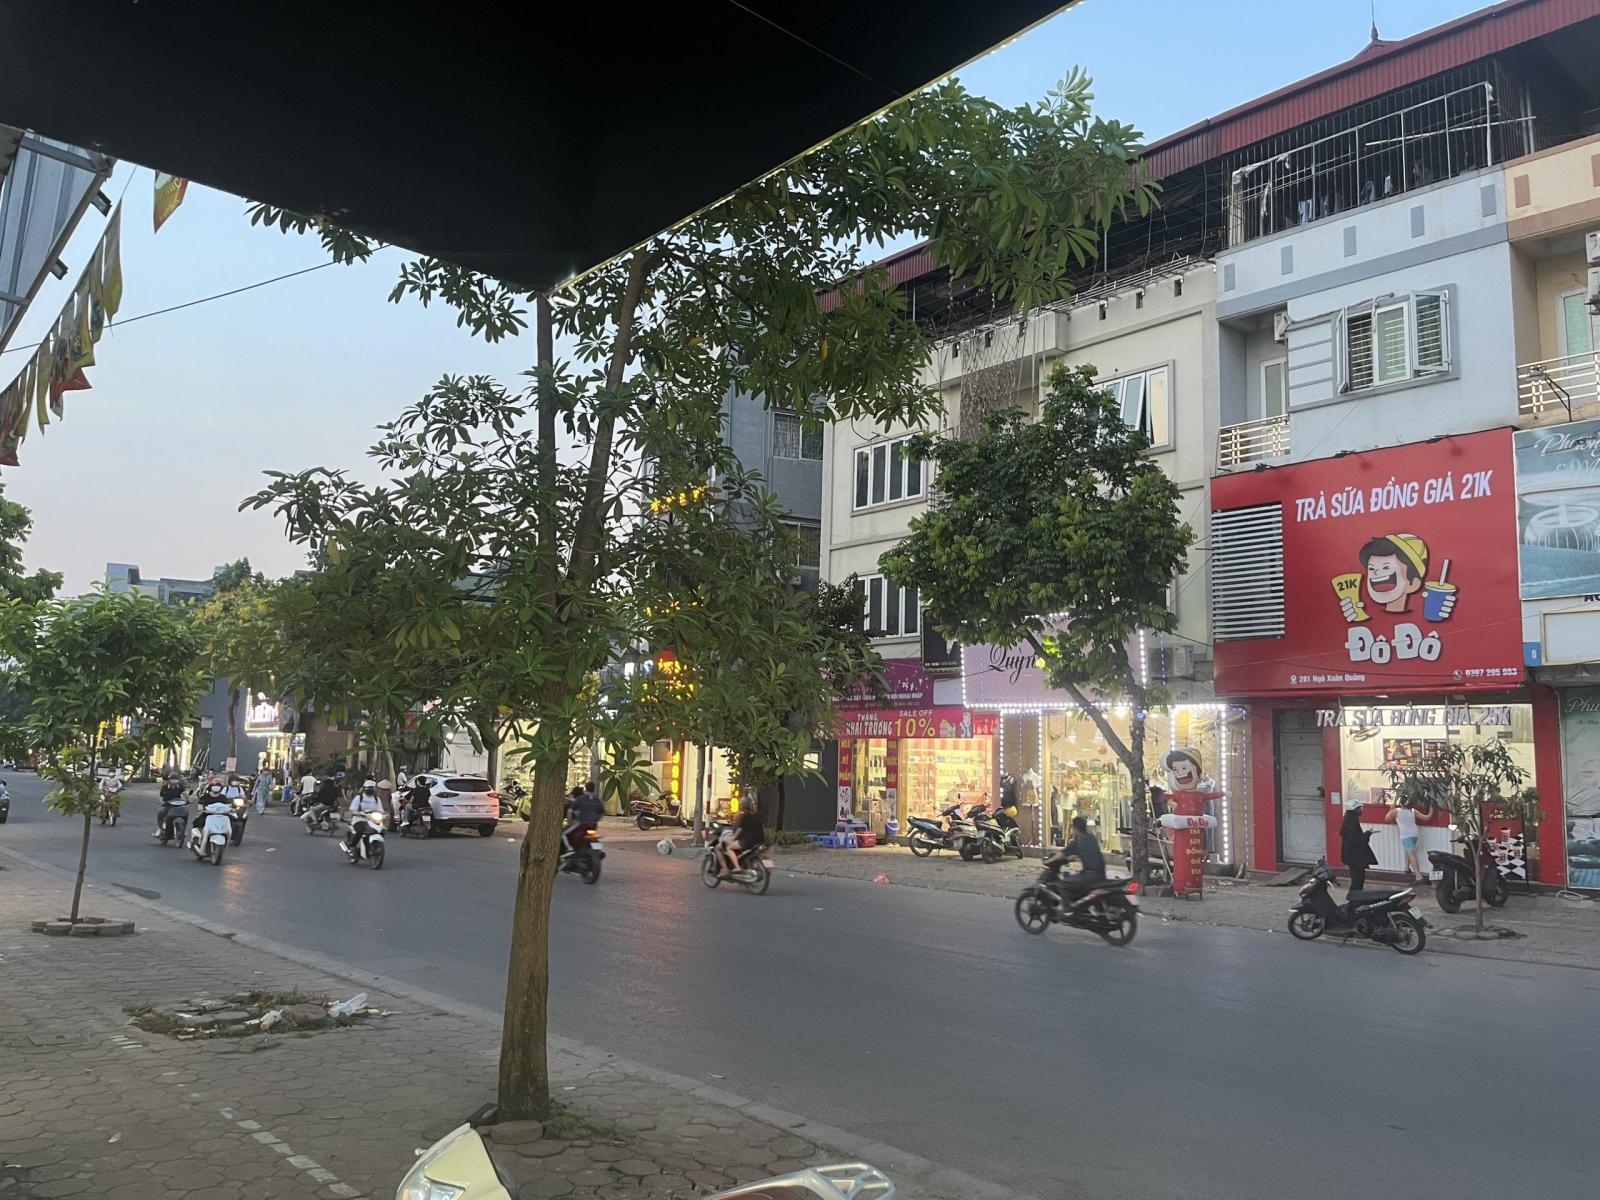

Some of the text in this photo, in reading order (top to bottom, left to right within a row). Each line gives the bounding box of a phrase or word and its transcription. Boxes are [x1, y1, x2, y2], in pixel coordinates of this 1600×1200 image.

[1295, 470, 1493, 522] TRÀ SỮA ĐỒNG GIÁ 21K
[1336, 579, 1358, 592] 21K
[919, 709, 934, 717] OFF
[895, 718, 936, 737] 10%
